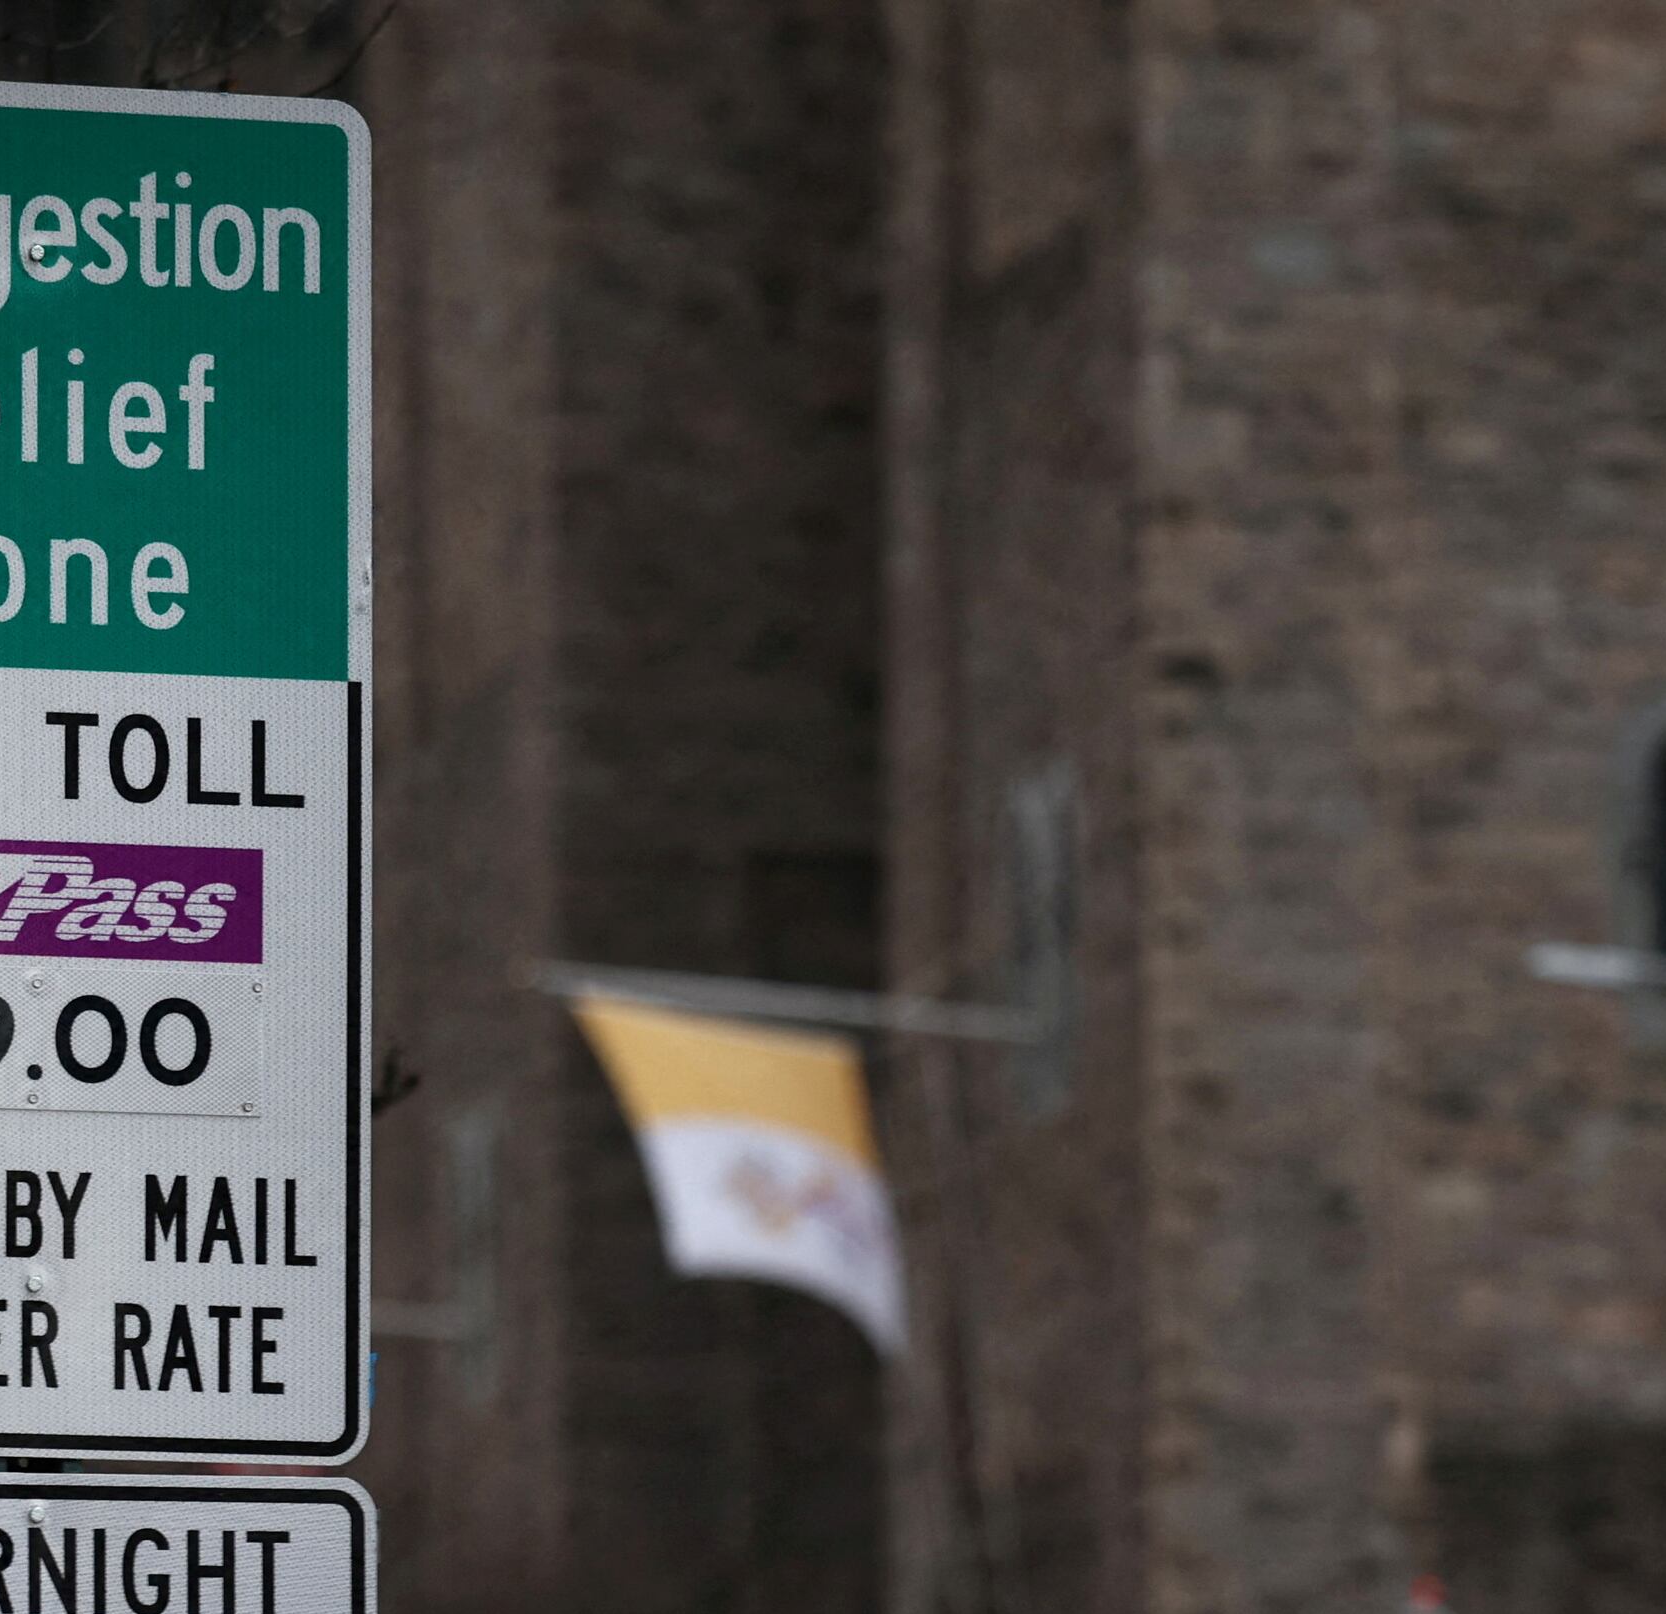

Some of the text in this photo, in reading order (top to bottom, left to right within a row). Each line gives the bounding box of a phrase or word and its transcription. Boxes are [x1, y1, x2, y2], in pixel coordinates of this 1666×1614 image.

[45, 711, 305, 808] TOLL
[4, 1169, 93, 1260] BY
[144, 1175, 318, 1267] MAIL
[113, 1302, 285, 1395] RATE
